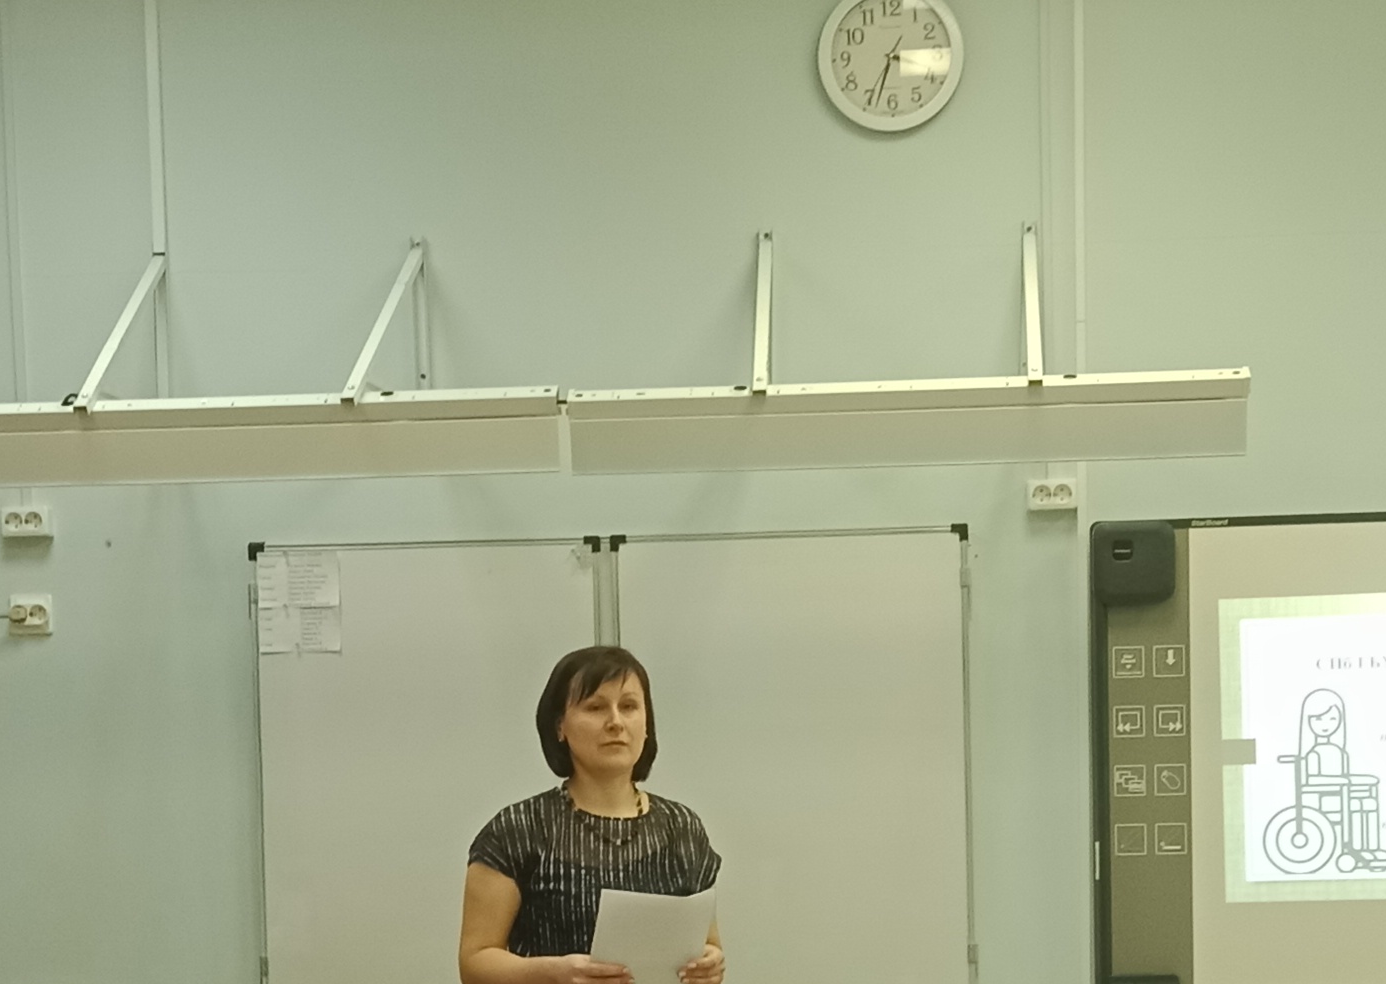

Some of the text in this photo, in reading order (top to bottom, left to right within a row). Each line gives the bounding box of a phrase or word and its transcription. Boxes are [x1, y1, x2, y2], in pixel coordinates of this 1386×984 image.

[861, 8, 875, 26] 11
[880, 0, 902, 17] 12
[912, 7, 918, 23] 1
[845, 28, 865, 46] 10
[923, 23, 936, 40] 2
[839, 51, 852, 68] 9
[844, 71, 858, 92] 8
[923, 67, 938, 85] 4
[864, 88, 876, 107] 7
[886, 92, 898, 111] 6
[910, 86, 922, 103] 5
